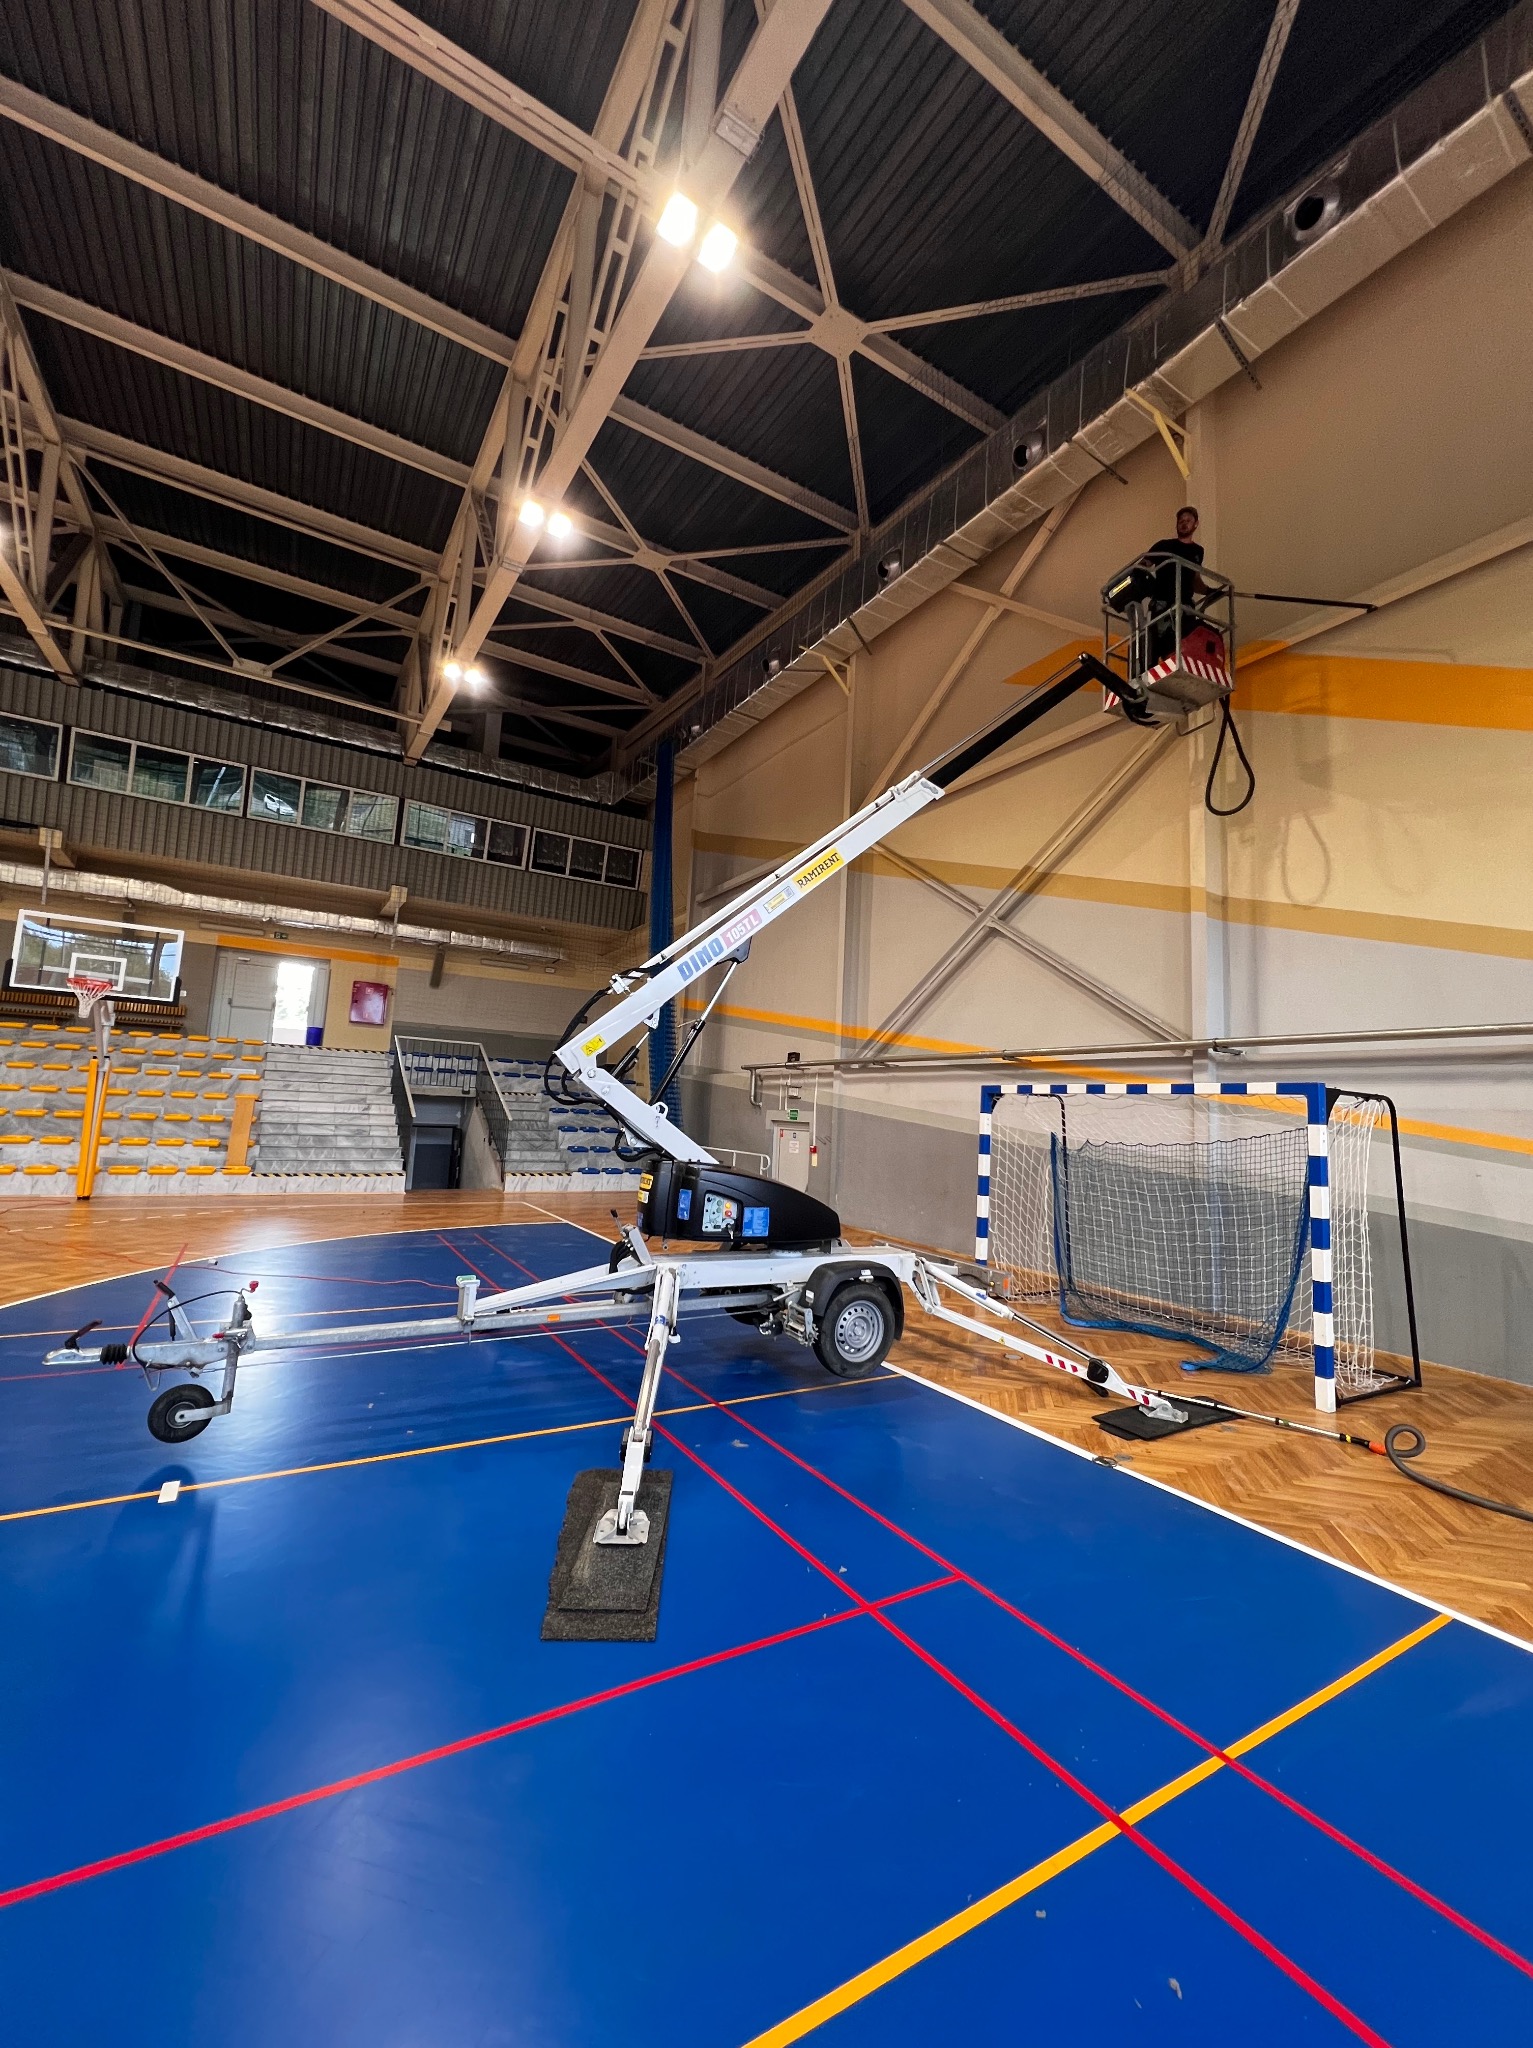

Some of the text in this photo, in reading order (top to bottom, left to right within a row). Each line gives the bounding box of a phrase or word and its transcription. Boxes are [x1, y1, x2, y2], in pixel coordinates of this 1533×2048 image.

[797, 853, 840, 888] RAMIRENT
[677, 914, 759, 982] DINO 105TL
